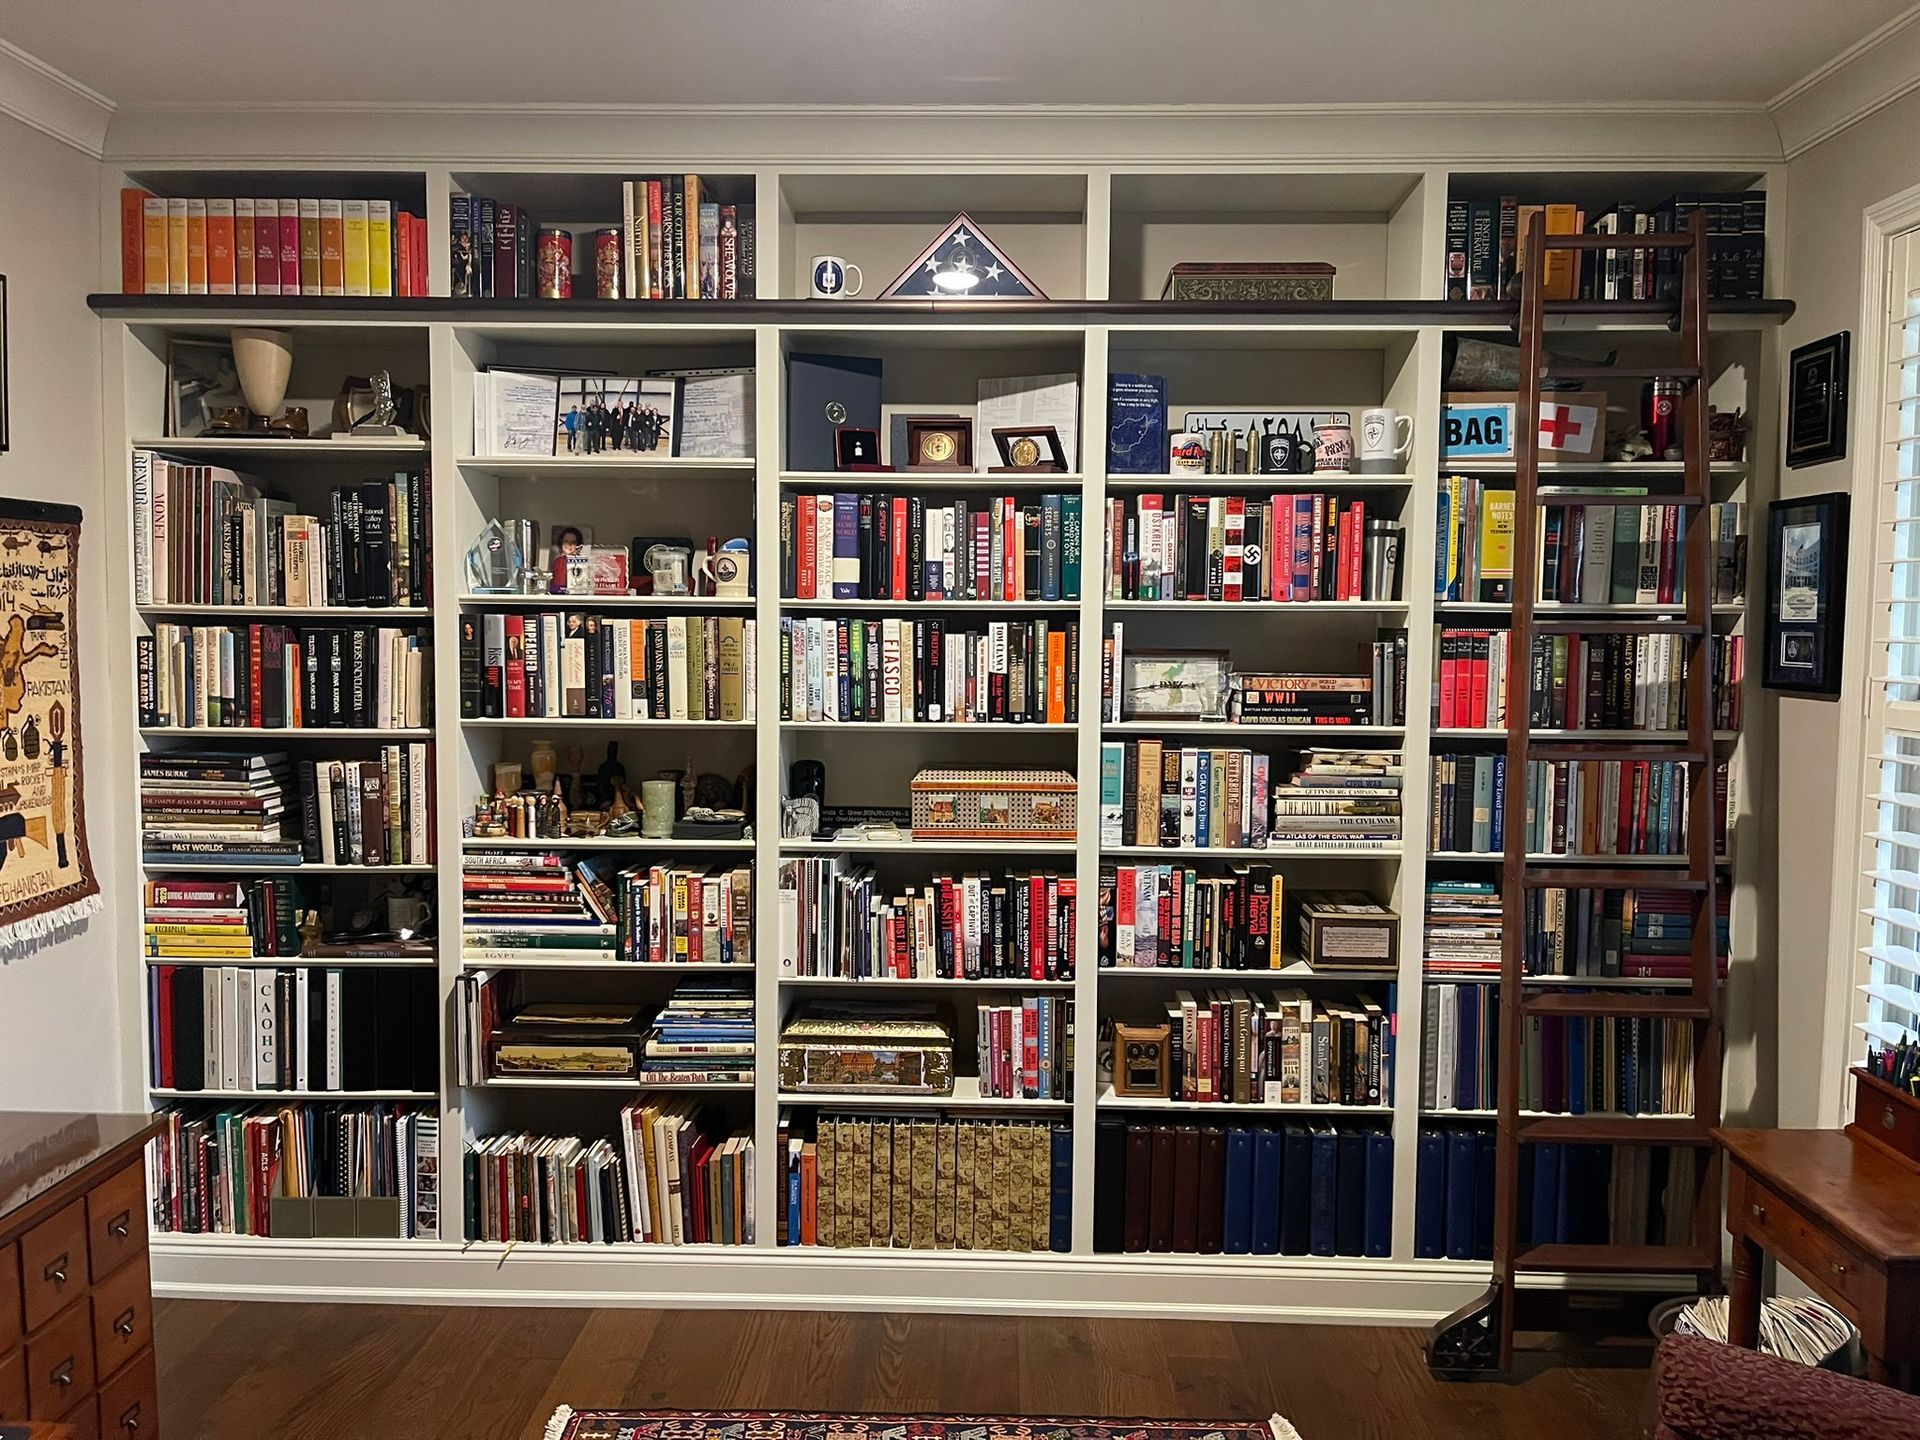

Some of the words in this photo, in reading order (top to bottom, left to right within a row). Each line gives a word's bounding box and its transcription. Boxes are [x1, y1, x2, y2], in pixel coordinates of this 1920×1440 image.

[674, 193, 682, 215] FOUR
[663, 206, 671, 232] WARS
[634, 216, 644, 256] Narnia
[674, 218, 682, 250] GOTHIC
[1474, 218, 1482, 272] LITERATURE
[1482, 218, 1490, 258] ENGLISH
[663, 260, 671, 288] ROSES
[1445, 416, 1502, 446] BAG
[134, 456, 148, 505] RENOIR
[154, 494, 164, 542] MONET
[806, 499, 814, 516] WAR
[1044, 507, 1052, 536] SECRETS
[1152, 514, 1161, 553] OSTKRIEG
[806, 526, 814, 567] DECISION
[911, 534, 921, 562] George
[911, 564, 921, 584] Tenet
[524, 620, 536, 671] IMPEACHED
[838, 627, 847, 654] UNDER
[996, 626, 1004, 641] TOM
[139, 641, 148, 670] DAVE
[838, 658, 847, 677] FIRE
[868, 644, 878, 670] SHADOWS
[885, 640, 899, 695] FIASCO
[996, 644, 1004, 671] CLANCY
[27, 681, 70, 696] PAKISTAN
[139, 674, 148, 710] BARRY
[353, 661, 364, 710] ENCYCLOPEDIA
[1256, 679, 1310, 689] VICTORY
[1264, 692, 1296, 703] WWII
[143, 770, 165, 778] JAMES
[166, 770, 188, 778] BURKE
[1199, 773, 1207, 793] GRAY
[1229, 754, 1238, 803] GETTYSBURG
[1257, 766, 1266, 786] CIVIL
[1495, 763, 1504, 777] God
[1495, 778, 1504, 787] So
[1199, 797, 1207, 811] FOX
[1257, 788, 1266, 804] WAR
[1284, 800, 1298, 814] THE
[1301, 800, 1324, 814] CIVIL
[1495, 789, 1504, 808] Loved
[183, 892, 215, 900] HANDBOOK
[1143, 869, 1151, 901] VIETNAM
[1172, 917, 1181, 929] WE
[1250, 895, 1260, 934] Interval
[1258, 895, 1269, 934] Decent
[896, 917, 909, 939] FIRST
[1172, 930, 1181, 945] HAD
[896, 942, 909, 951] IN
[261, 985, 273, 1063] CAOHC
[1238, 1007, 1248, 1026] Alan
[1238, 1028, 1248, 1072] Greenspan
[1316, 1036, 1328, 1070] Stanley
[646, 1072, 656, 1082] Off
[658, 1072, 670, 1082] The
[671, 1072, 691, 1082] Beaten
[693, 1072, 705, 1082] Path
[260, 1152, 269, 1171] ACLS
